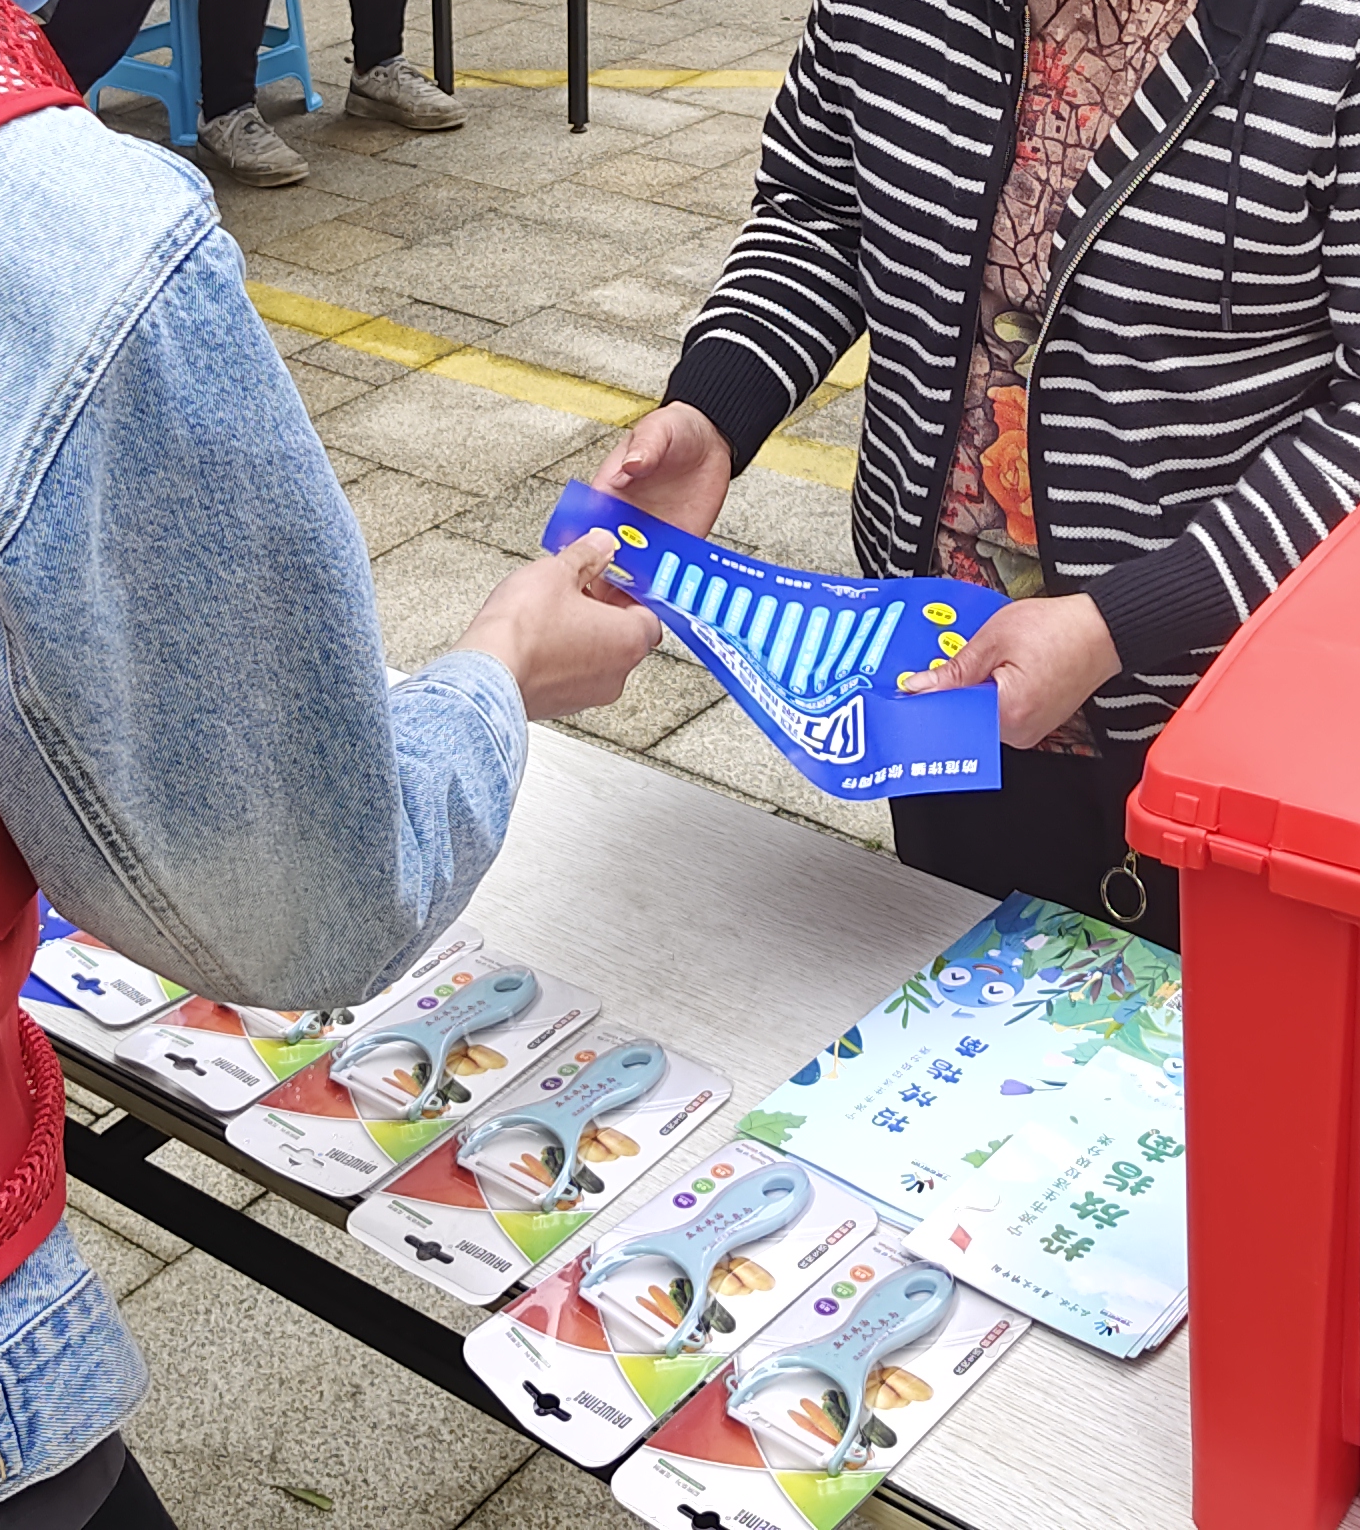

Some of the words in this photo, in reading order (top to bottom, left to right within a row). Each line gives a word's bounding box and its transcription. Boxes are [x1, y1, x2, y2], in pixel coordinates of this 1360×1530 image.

[1007, 1133, 1115, 1236] 宁波市生活垃圾分类
[1040, 1129, 1185, 1261] 投放指南
